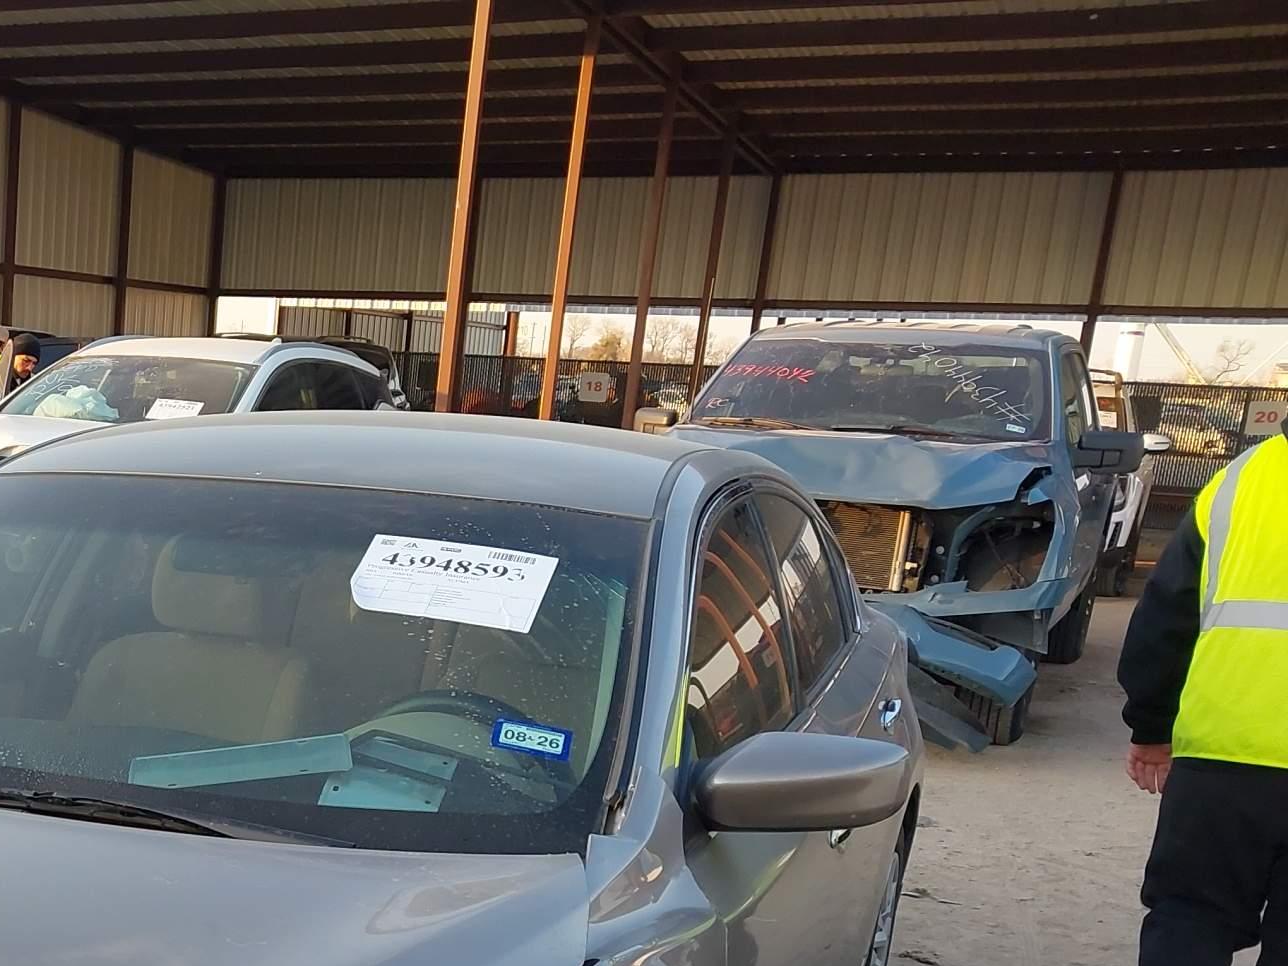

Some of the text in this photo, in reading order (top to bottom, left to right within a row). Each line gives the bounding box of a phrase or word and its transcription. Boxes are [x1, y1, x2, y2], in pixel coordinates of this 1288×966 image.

[586, 380, 603, 392] 18
[1254, 410, 1279, 424] 20
[380, 551, 526, 582] 43948593
